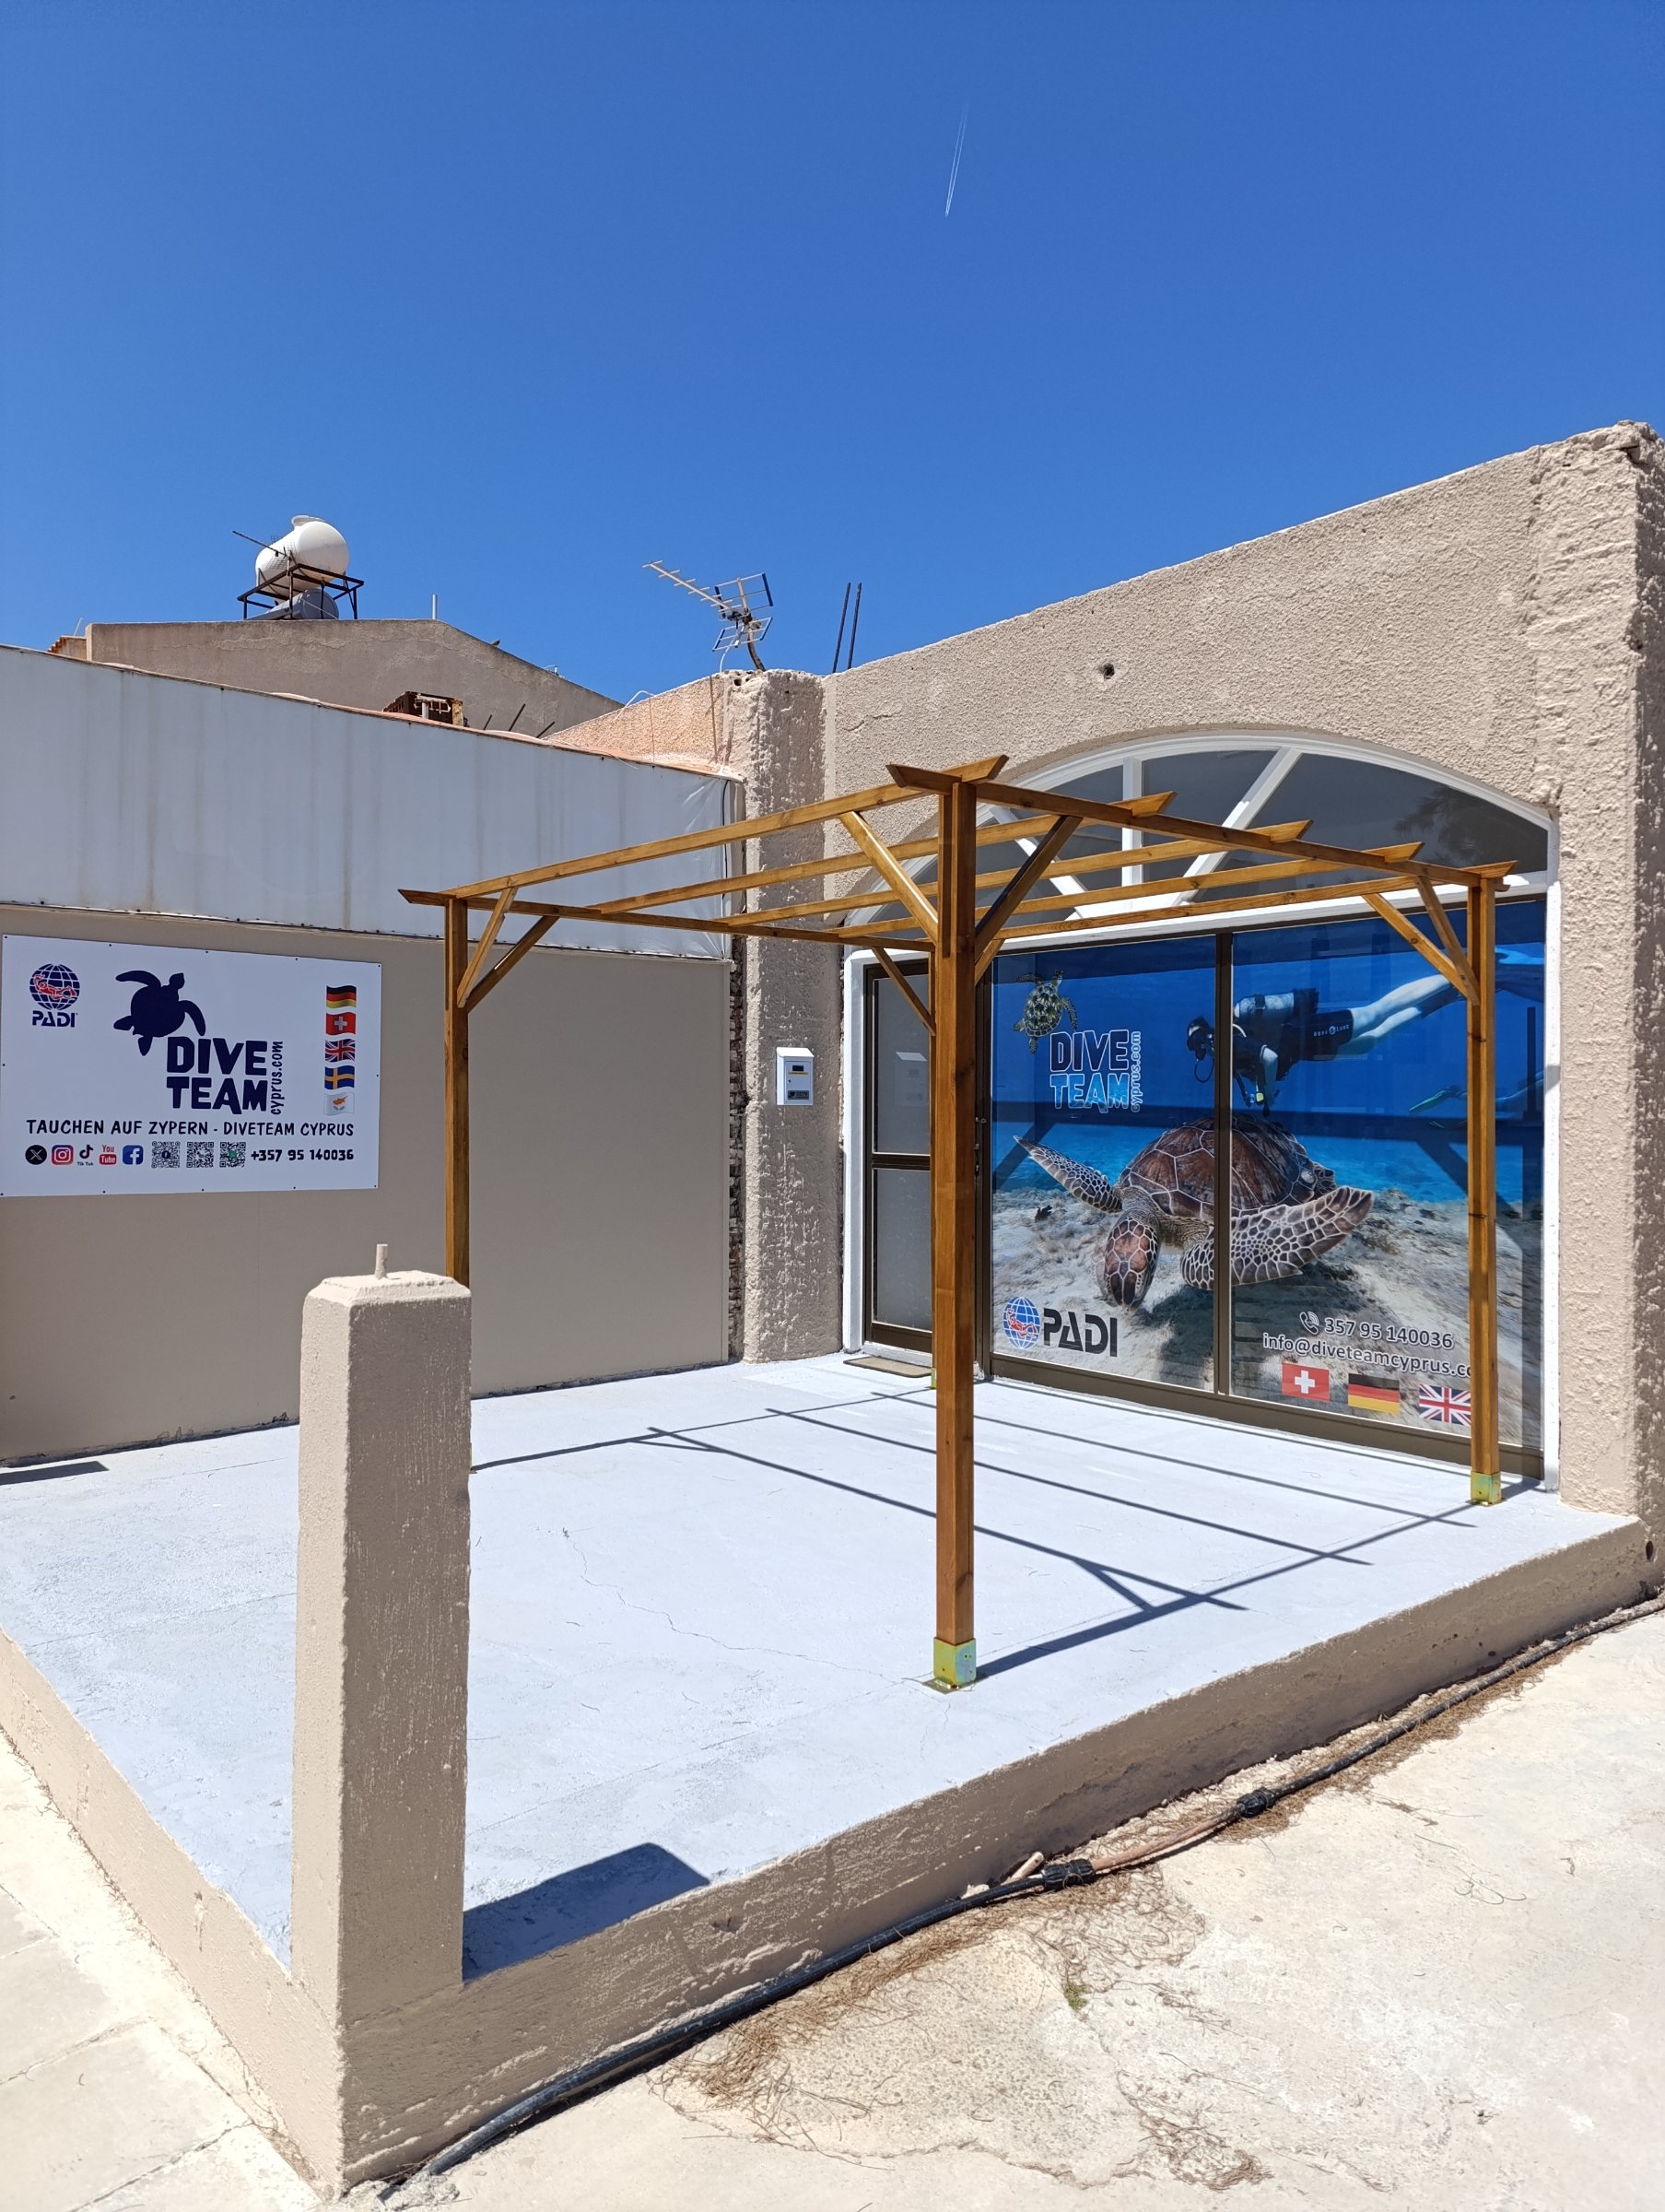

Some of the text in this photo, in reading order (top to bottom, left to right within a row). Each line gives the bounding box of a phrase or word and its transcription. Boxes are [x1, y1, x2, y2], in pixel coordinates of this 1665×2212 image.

[32, 1010, 76, 1028] PADI
[167, 1036, 268, 1076] DIVE
[1050, 1030, 1130, 1072] DIVE
[270, 1041, 285, 1115] cyprus.com
[1131, 1031, 1143, 1113] cyprus.com
[167, 1076, 268, 1114] TEAM
[1050, 1073, 1130, 1113] TEAM
[26, 1119, 104, 1135] TAUCHEN
[111, 1121, 142, 1135] AUF
[148, 1121, 208, 1135] ZYPERN
[223, 1122, 295, 1135] DIVETEAM
[300, 1123, 354, 1136] CYPRUS
[100, 1156, 116, 1164] Tube
[102, 1144, 115, 1153] You
[251, 1148, 354, 1161] +357 95 140036
[1043, 1307, 1118, 1358] PADI
[1324, 1317, 1454, 1349] 357 95 140036
